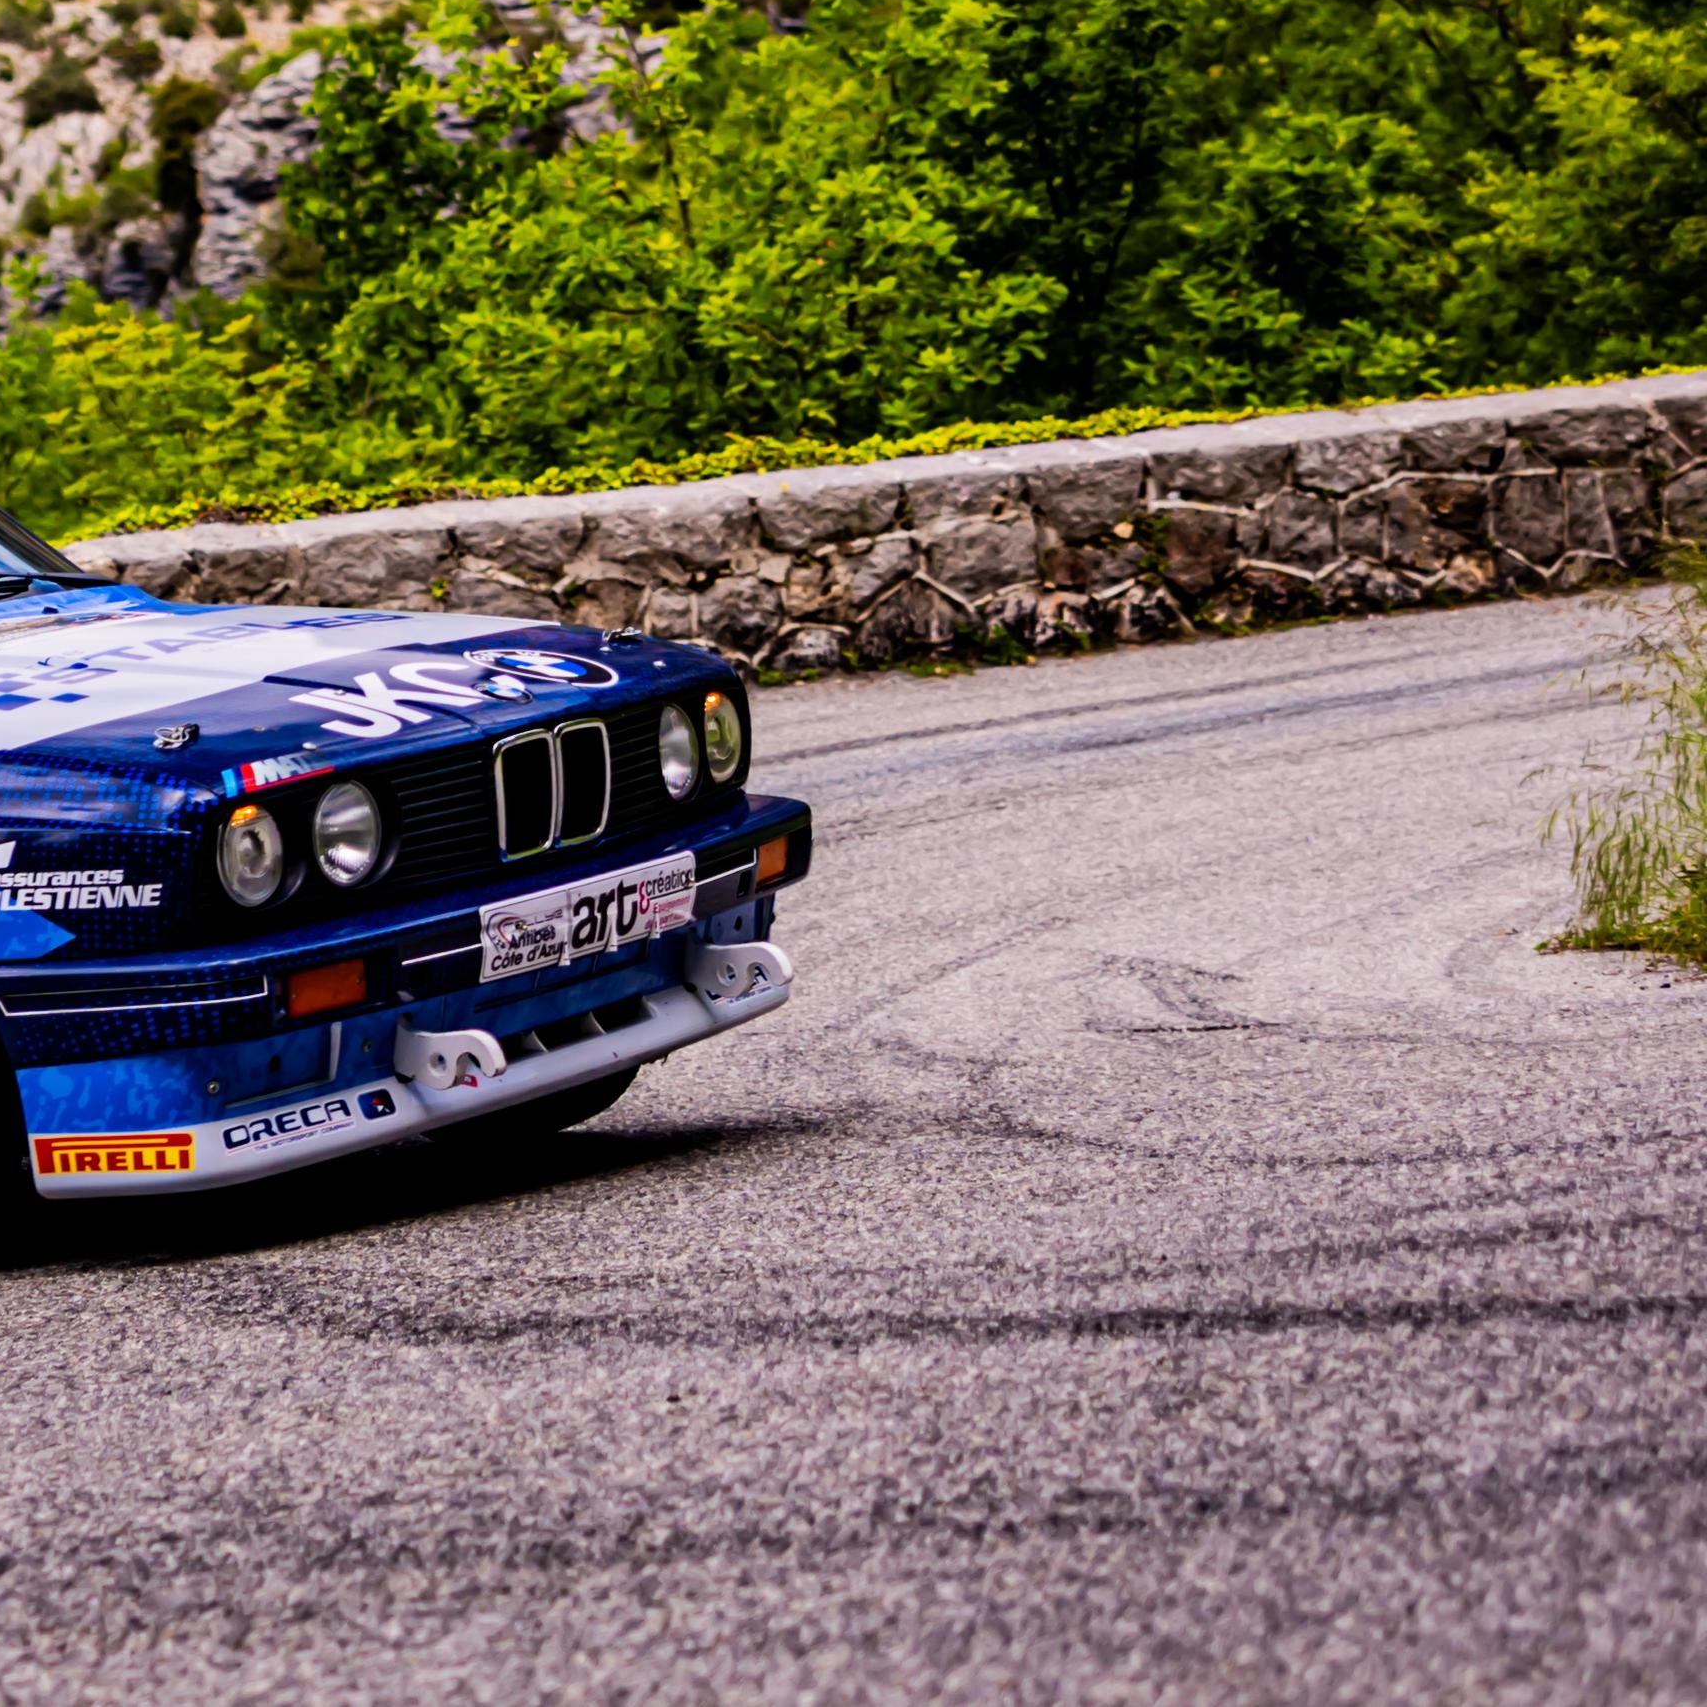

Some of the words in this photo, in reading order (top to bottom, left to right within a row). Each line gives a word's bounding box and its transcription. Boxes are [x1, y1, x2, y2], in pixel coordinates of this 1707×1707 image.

[31, 612, 415, 684] STABLES
[0, 883, 162, 911] LESTIENNE
[572, 879, 638, 949] art
[508, 925, 556, 950] Antibes
[491, 951, 523, 971] Côte
[223, 1099, 352, 1149] ORECA
[34, 1133, 193, 1174] PIRELLI
